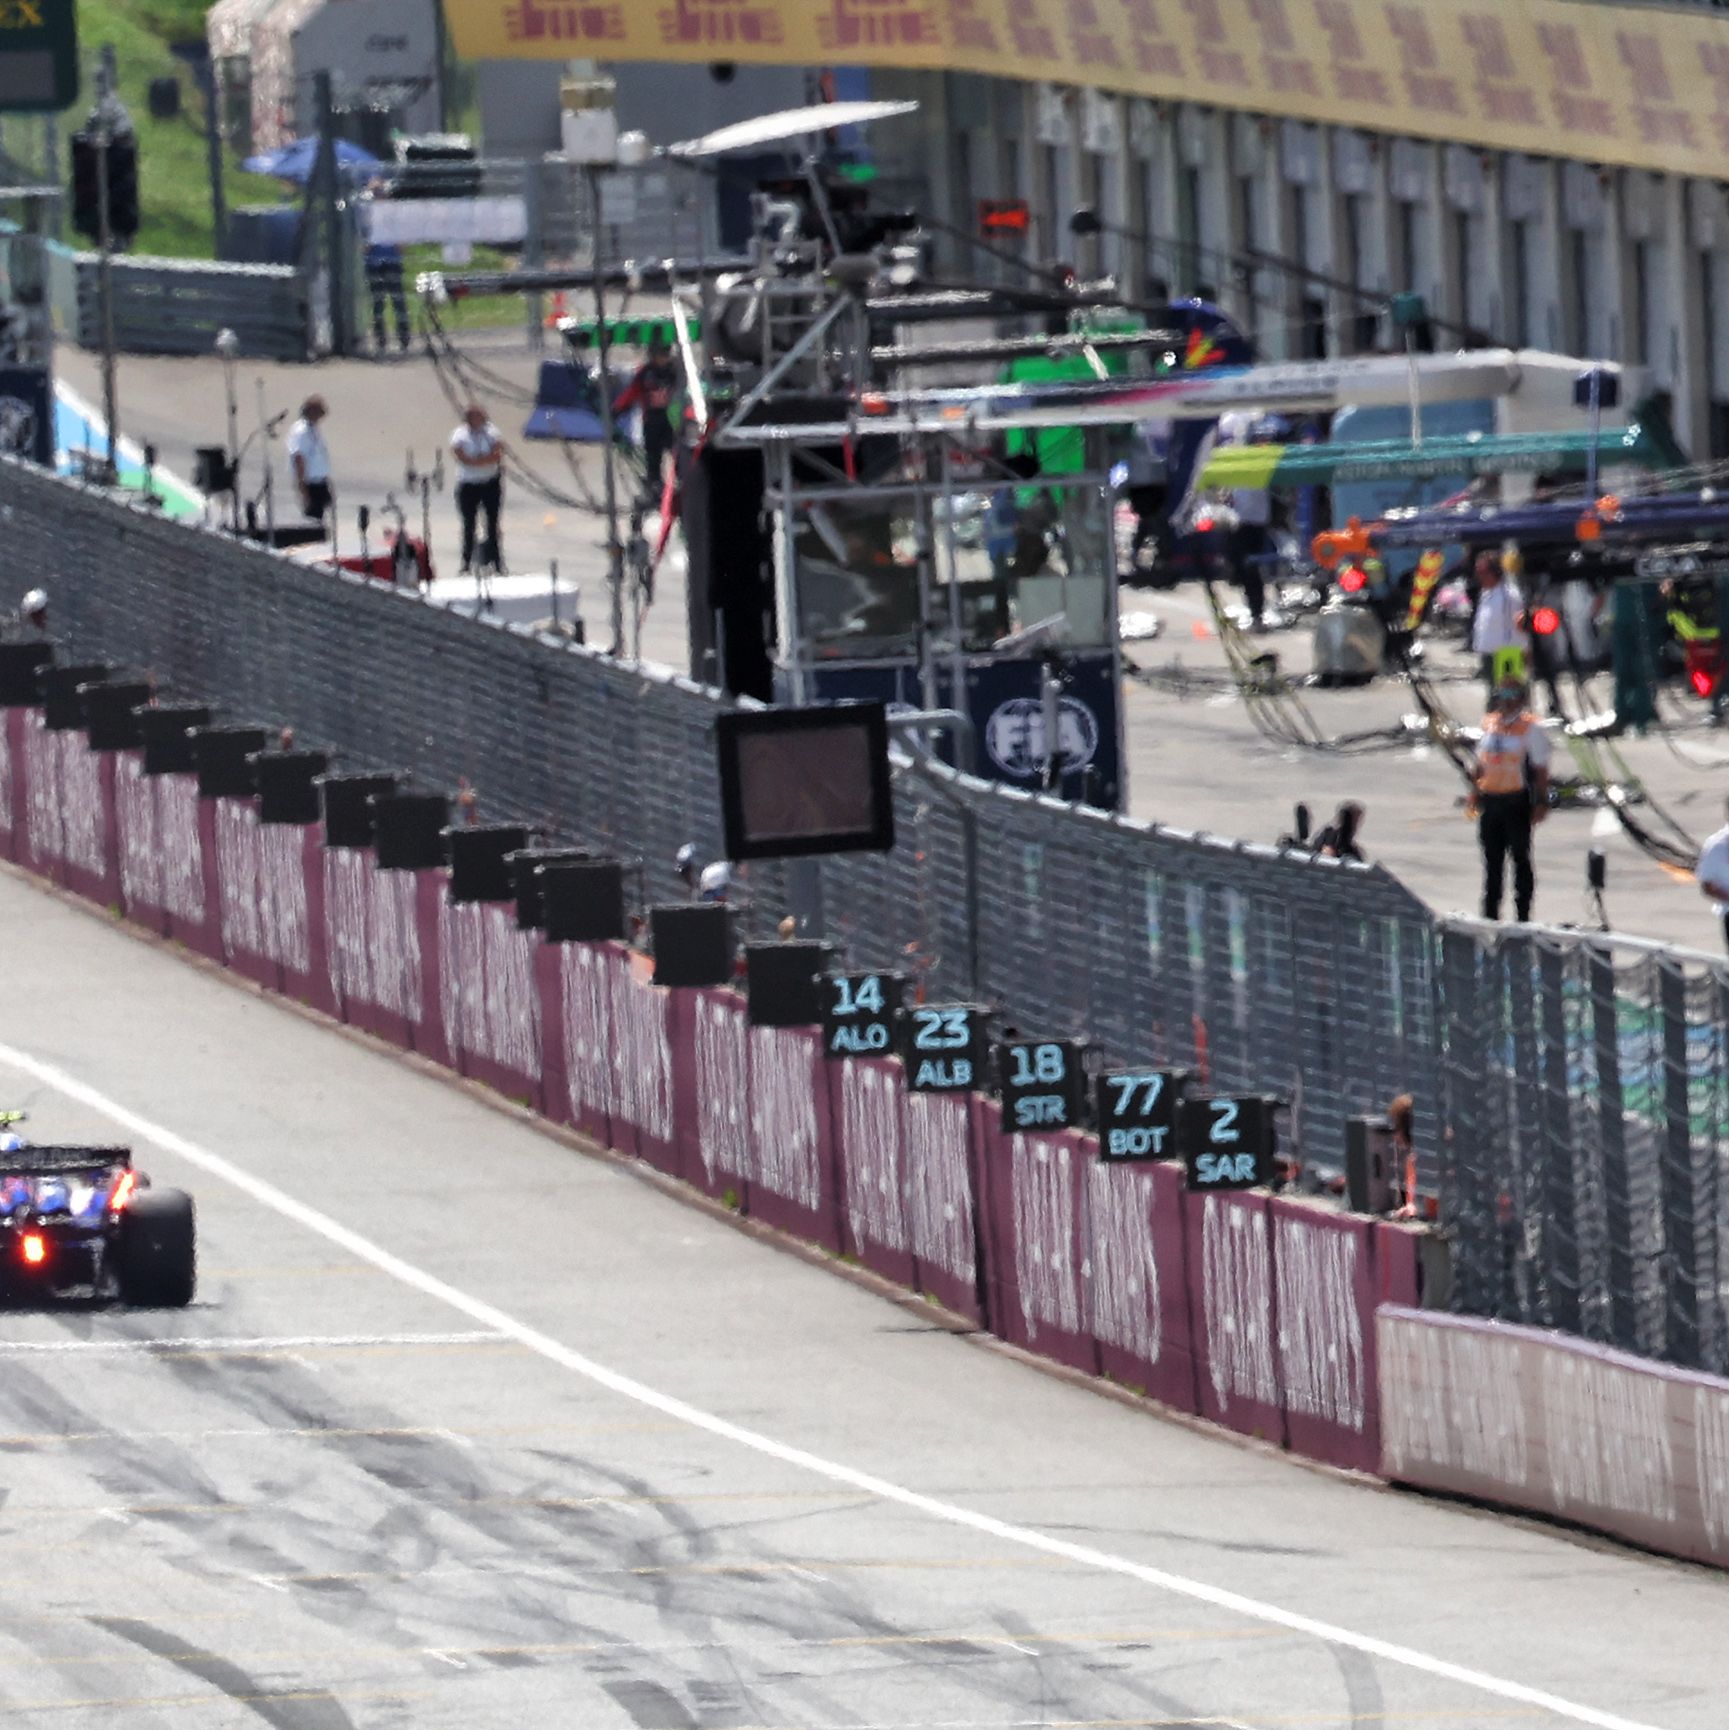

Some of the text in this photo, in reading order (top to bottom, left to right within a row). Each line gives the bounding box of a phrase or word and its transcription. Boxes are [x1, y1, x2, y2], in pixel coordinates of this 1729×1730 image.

[832, 975, 885, 1015] 14
[830, 1022, 888, 1051] ALO
[913, 1009, 970, 1050] 23
[915, 1058, 972, 1088] ALB
[1010, 1044, 1065, 1086] 18
[1014, 1095, 1068, 1126] STR
[1106, 1074, 1164, 1116] 77
[1208, 1100, 1240, 1143] 2
[1108, 1126, 1169, 1156] BOT
[1194, 1152, 1257, 1183] SAR
